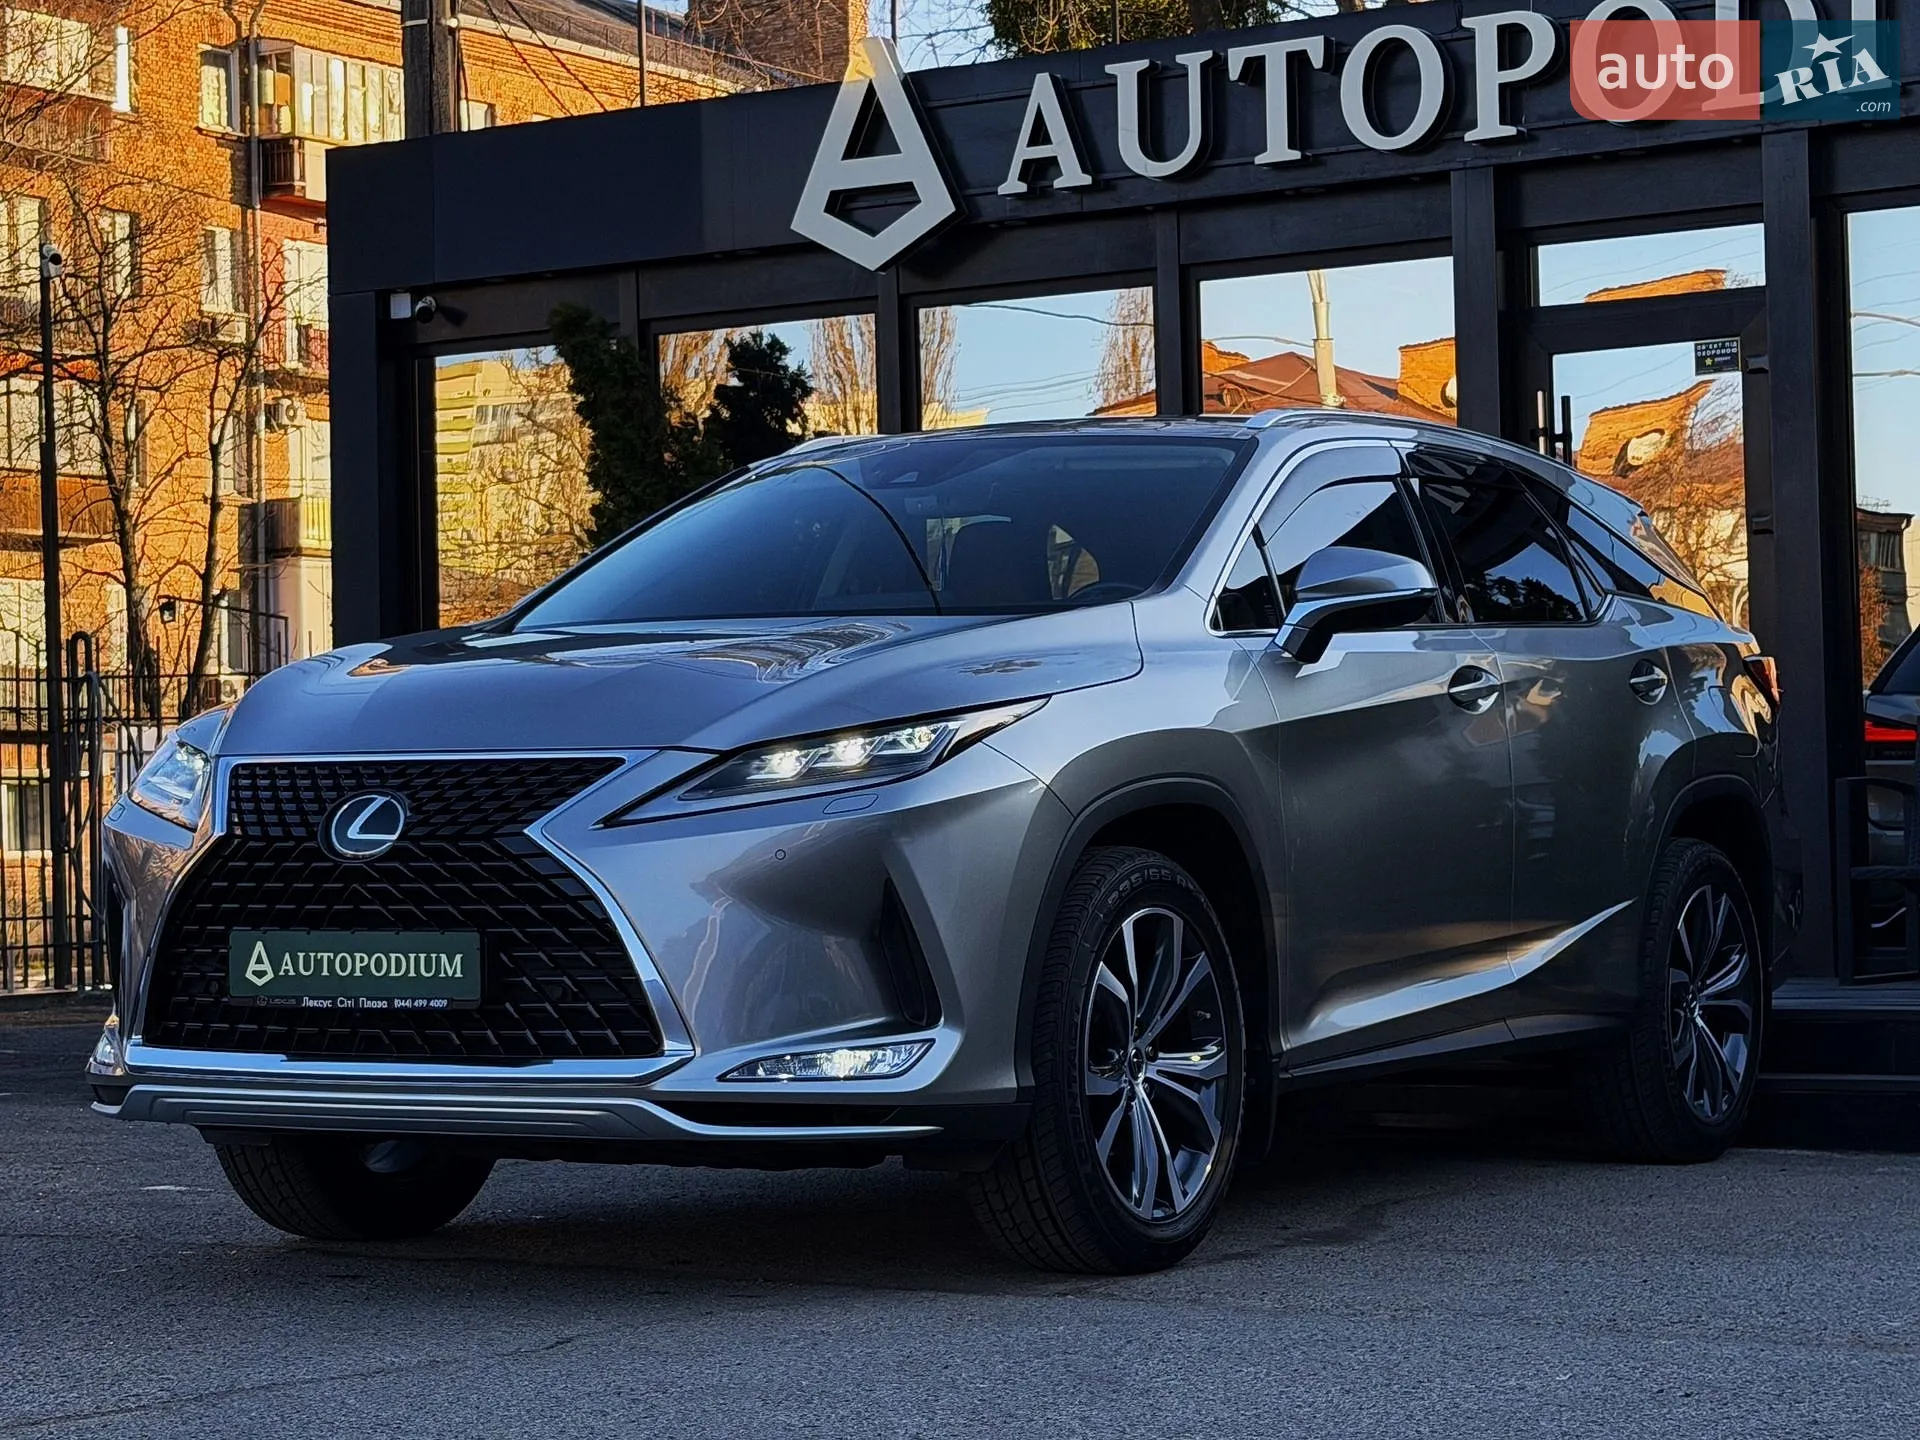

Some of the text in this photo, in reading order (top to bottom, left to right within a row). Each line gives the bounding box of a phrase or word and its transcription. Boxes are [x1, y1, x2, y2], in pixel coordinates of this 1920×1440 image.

[279, 952, 464, 977] AUTOPODIUM
[302, 997, 333, 1008] Лексус
[359, 997, 388, 1008] Плаза
[394, 998, 412, 1008] (044)
[413, 999, 427, 1008] 499
[429, 998, 448, 1008] 4009
